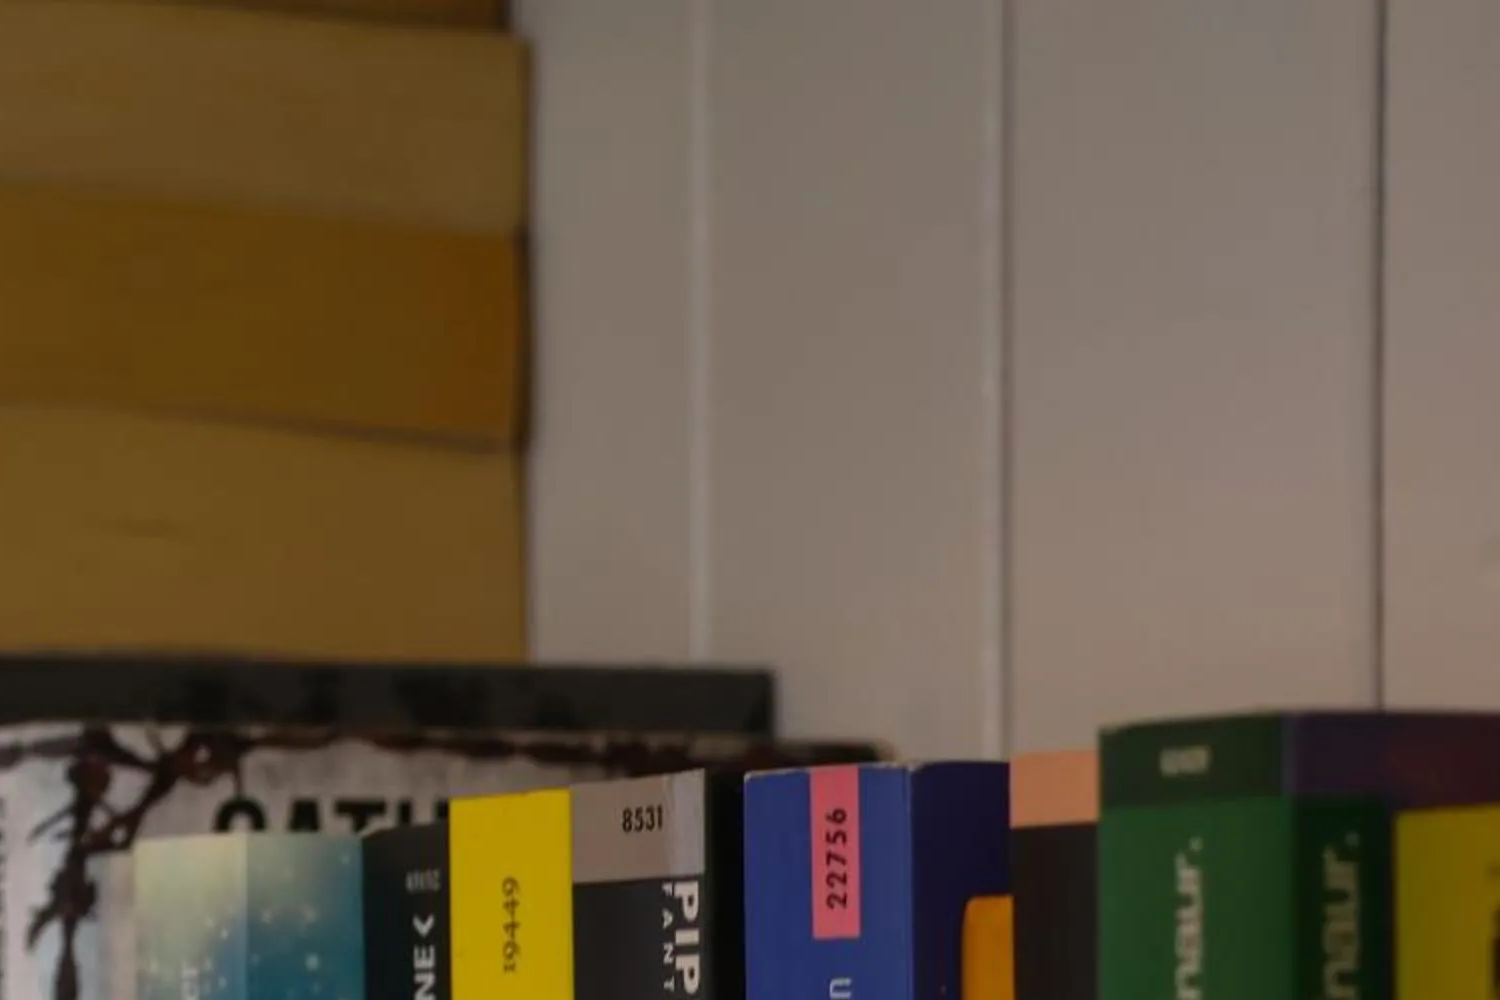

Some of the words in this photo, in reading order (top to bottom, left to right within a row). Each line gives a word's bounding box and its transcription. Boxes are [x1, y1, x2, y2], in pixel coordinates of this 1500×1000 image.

[621, 803, 665, 833] 8531
[824, 806, 848, 909] 22756
[501, 875, 520, 974] 19449
